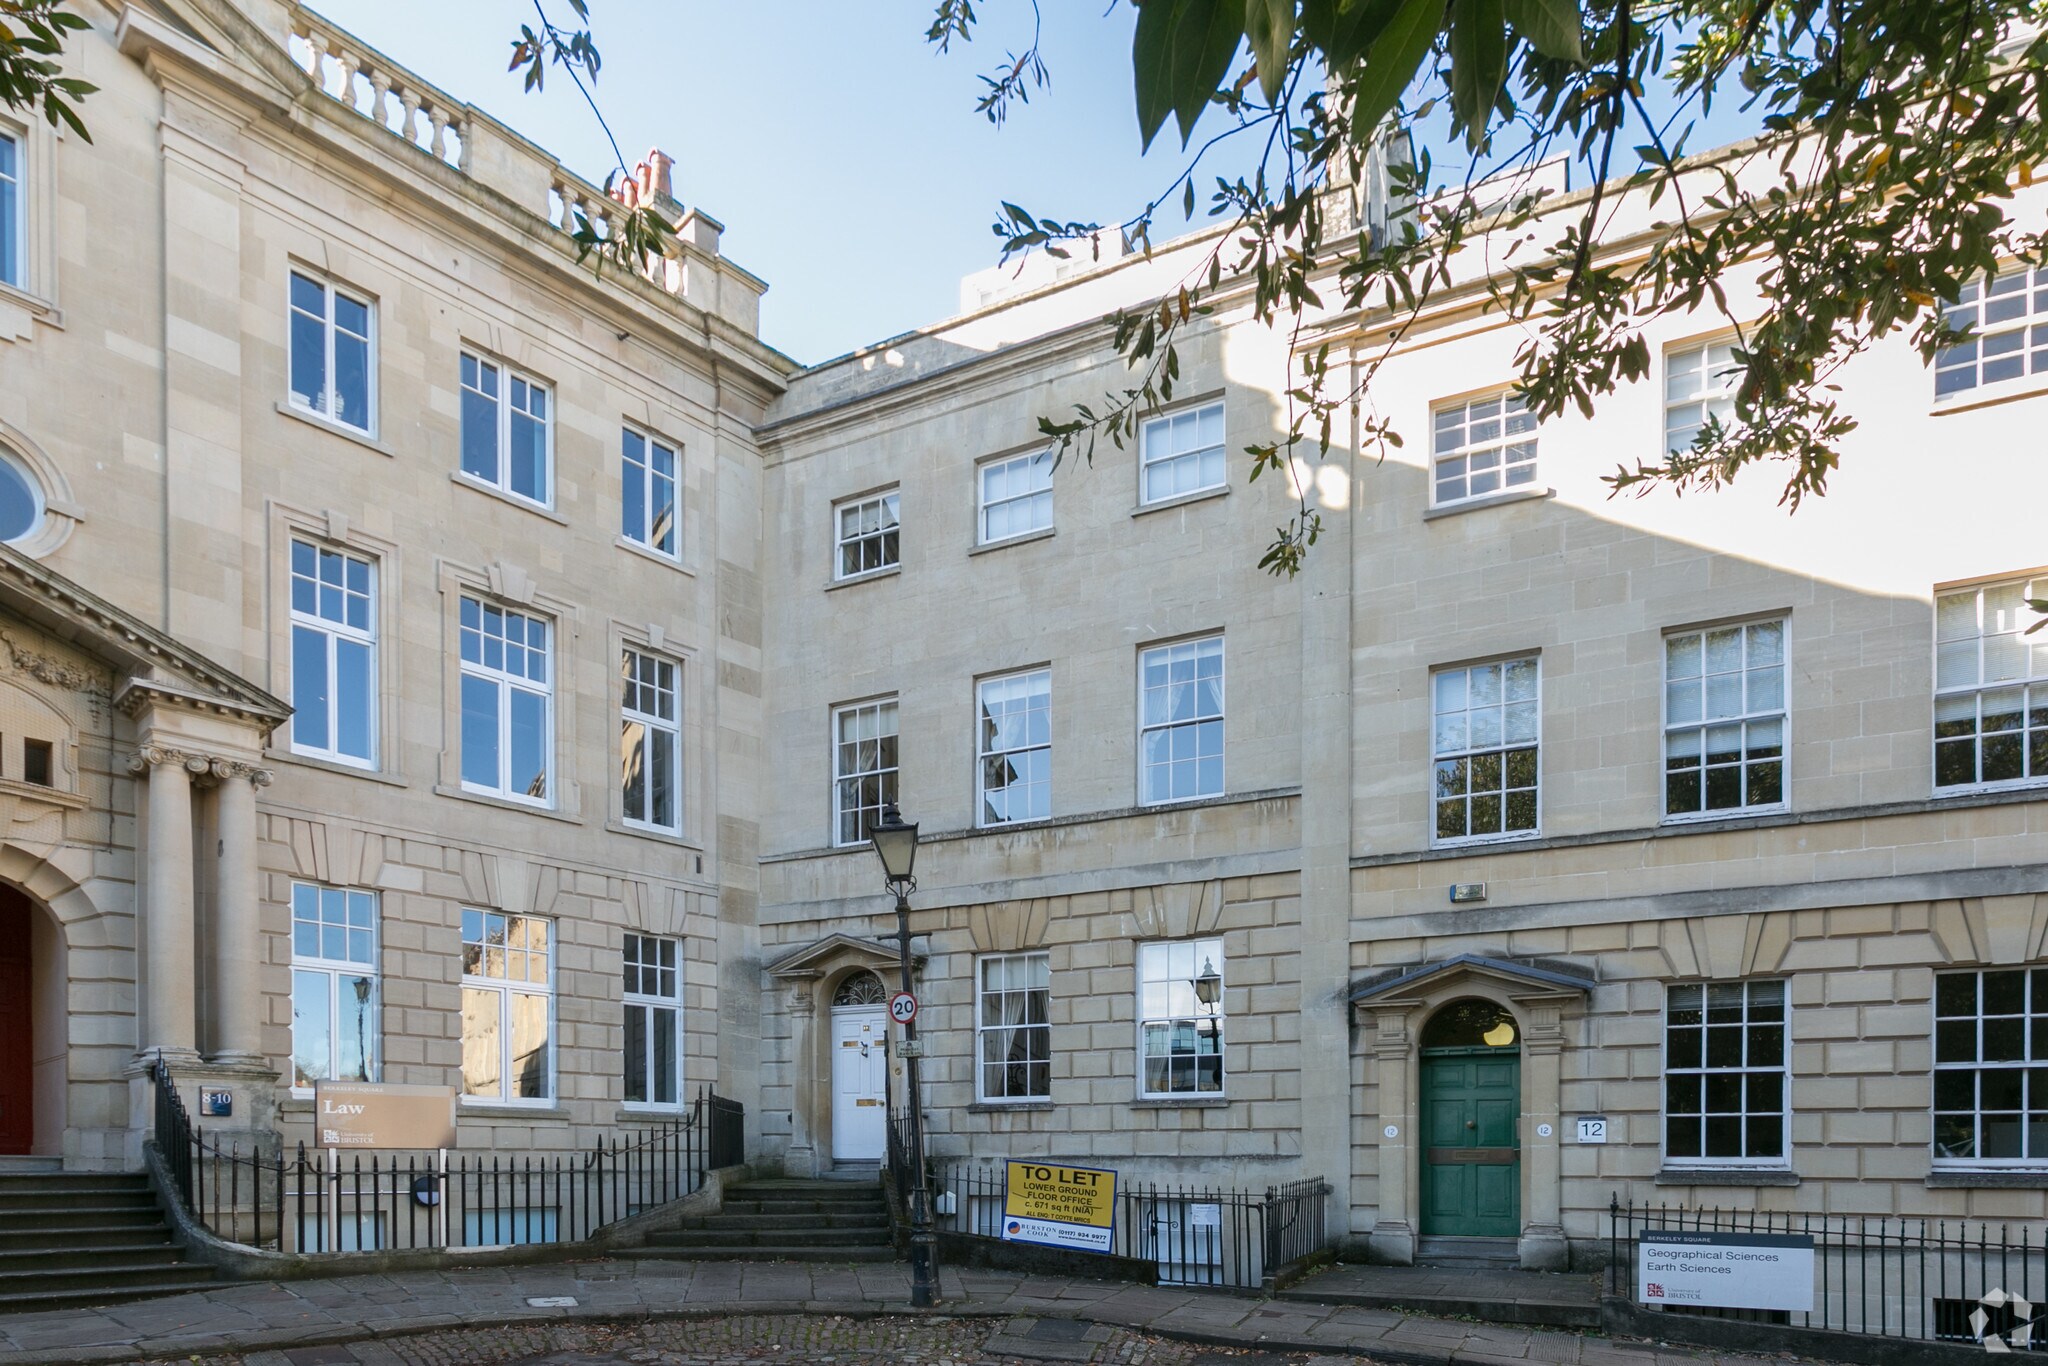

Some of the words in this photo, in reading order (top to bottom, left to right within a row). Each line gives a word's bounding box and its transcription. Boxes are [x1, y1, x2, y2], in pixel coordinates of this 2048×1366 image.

[894, 1000, 914, 1015] 20
[202, 1092, 232, 1104] 8-10
[323, 1099, 366, 1114] Law
[1387, 1128, 1395, 1136] 12
[1581, 1122, 1603, 1136] 12
[1021, 1166, 1052, 1181] TO
[1059, 1169, 1102, 1187] LET
[1023, 1182, 1056, 1192] LOWER
[1058, 1186, 1098, 1197] GROUND
[1027, 1191, 1058, 1202] FLOOR
[1060, 1195, 1093, 1206] OFFICE
[1034, 1201, 1048, 1210] 671
[1051, 1204, 1062, 1212] sq
[1072, 1205, 1094, 1216] (NIA)
[1021, 1224, 1057, 1233] BURSTON
[1647, 1248, 1723, 1260] Geographical
[1725, 1251, 1779, 1262] Sciences
[1647, 1262, 1677, 1271] Earth
[1679, 1263, 1732, 1274] Sciences
[1667, 1292, 1703, 1300] BRISTOL
